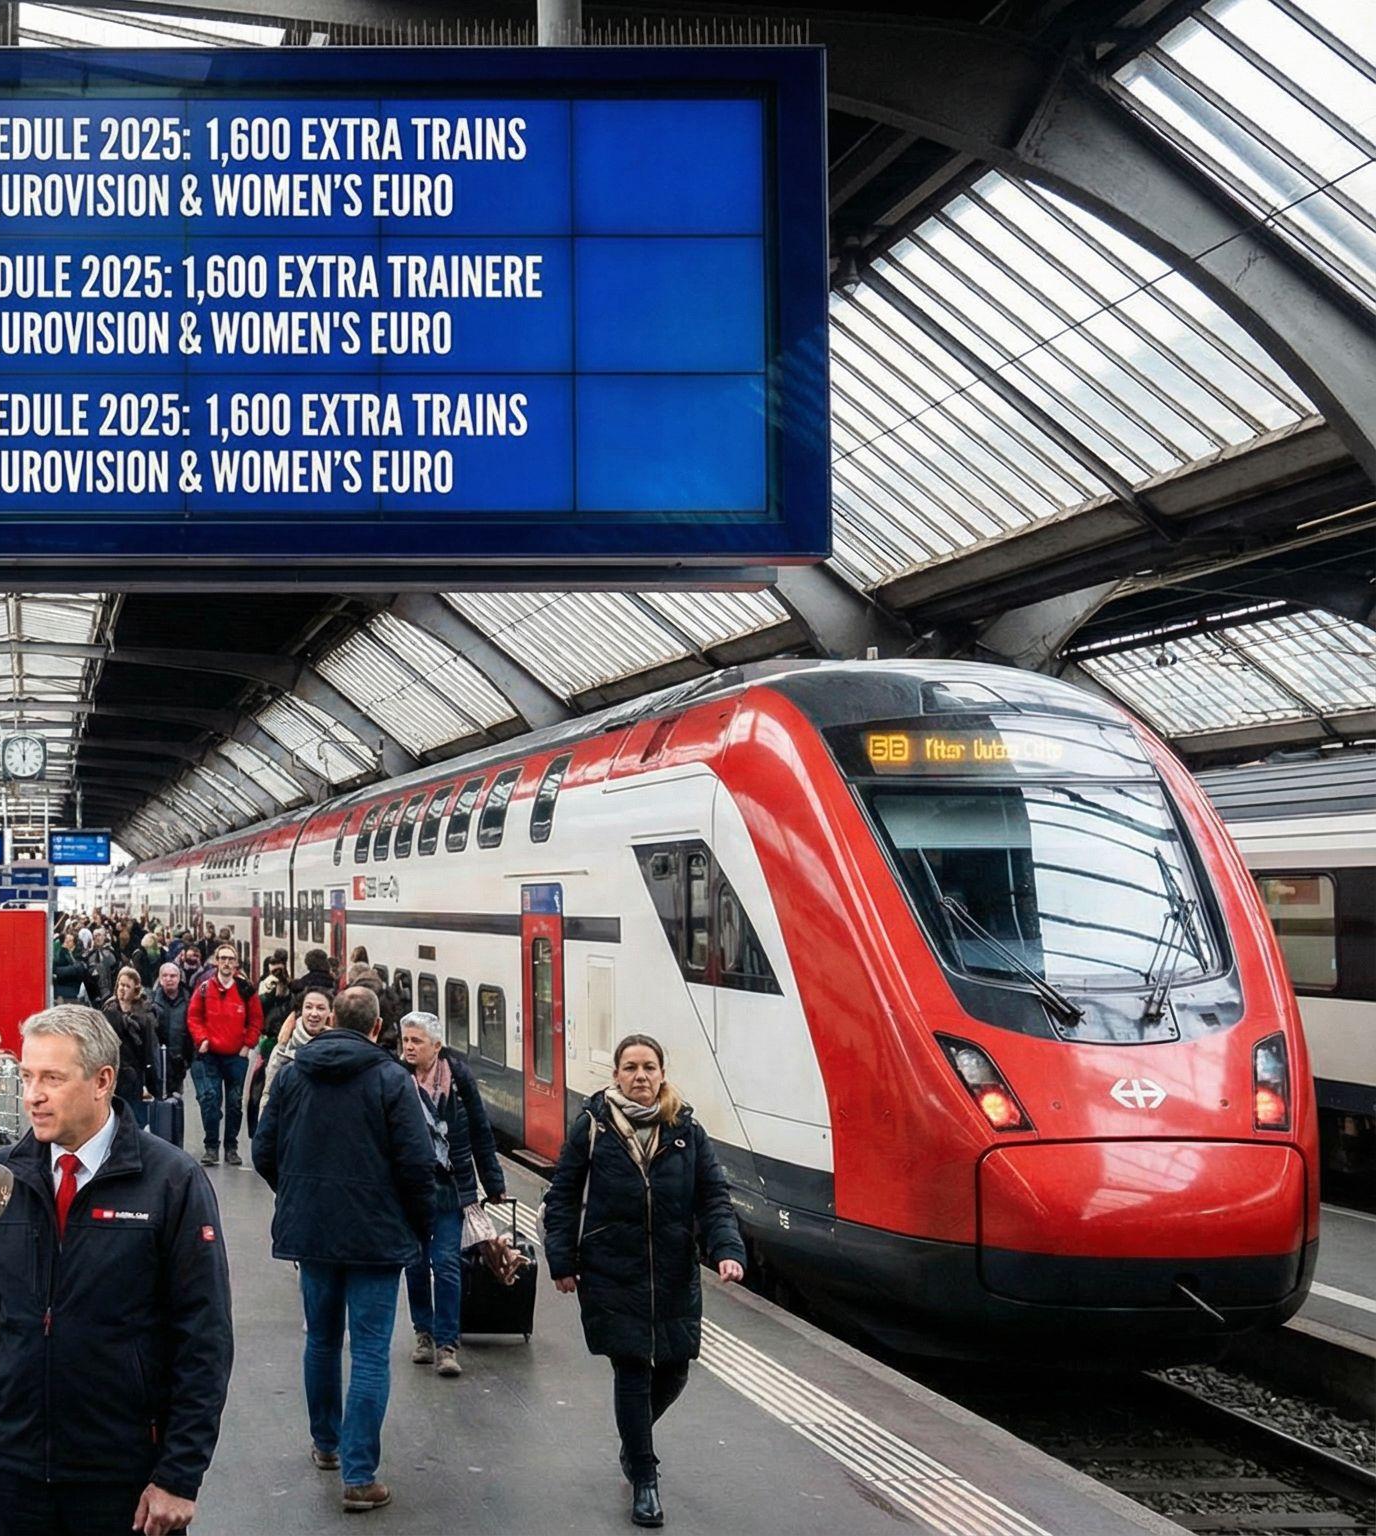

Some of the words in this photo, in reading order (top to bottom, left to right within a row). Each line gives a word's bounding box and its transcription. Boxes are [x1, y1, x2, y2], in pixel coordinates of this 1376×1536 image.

[99, 117, 191, 161] 2025:
[206, 117, 291, 167] 1,600
[302, 117, 403, 161] EXTRA
[411, 117, 527, 161] TRAINS
[179, 173, 203, 217] &
[373, 173, 453, 217] EURO
[81, 254, 173, 299] 2025:
[182, 254, 267, 305] 1,600
[278, 254, 380, 299] EXTRA
[387, 254, 543, 299] TRAINERE
[178, 311, 202, 355] &
[210, 311, 361, 355] WOMEN'S
[371, 311, 452, 355] EURO
[98, 393, 190, 437] 2025:
[206, 393, 291, 443] 1,600
[302, 393, 403, 437] EXTRA
[412, 393, 528, 437] TRAINS
[178, 449, 203, 494] &
[372, 449, 453, 494] EURO
